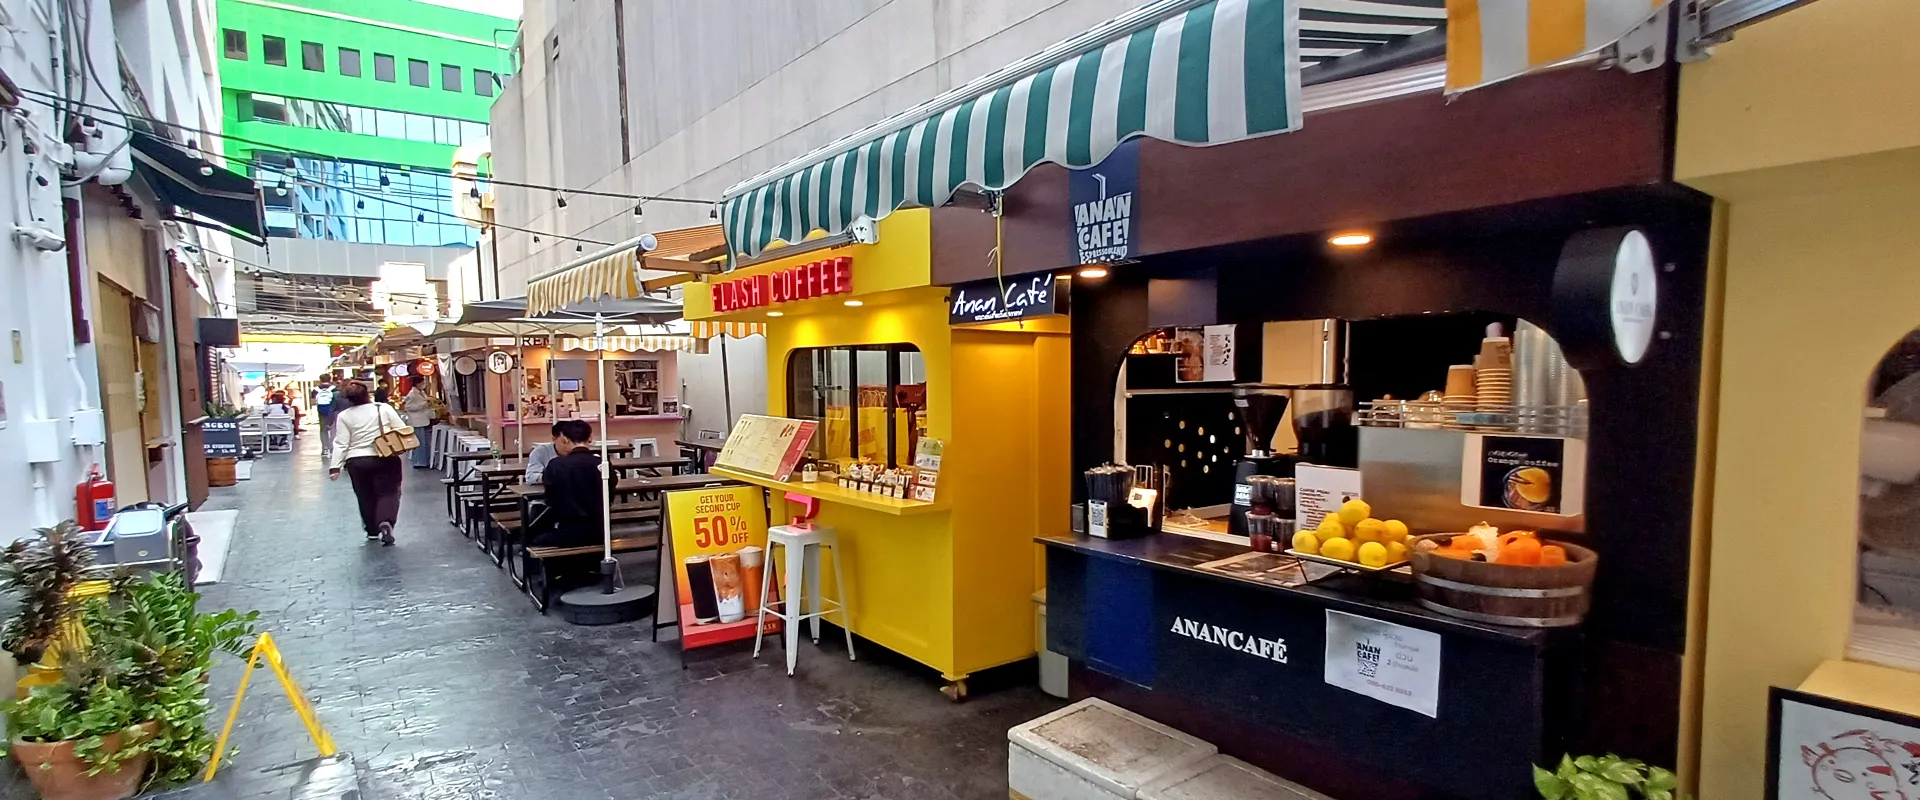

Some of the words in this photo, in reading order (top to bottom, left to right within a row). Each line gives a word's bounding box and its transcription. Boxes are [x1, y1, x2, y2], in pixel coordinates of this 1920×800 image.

[1074, 192, 1132, 226] ANAN
[1077, 218, 1130, 250] CAFE!
[711, 274, 767, 312] FLASH
[770, 257, 852, 302] COFFEE
[952, 290, 996, 315] Anan
[1004, 273, 1052, 308] Café
[1487, 457, 1520, 466] Orange
[695, 504, 725, 514] SECOND
[725, 502, 741, 512] CUP
[700, 495, 713, 504] GET
[714, 493, 734, 503] YOUR
[731, 532, 749, 544] OFF
[1170, 616, 1288, 664] ANANCAFÉ
[1356, 641, 1381, 655] ANAN
